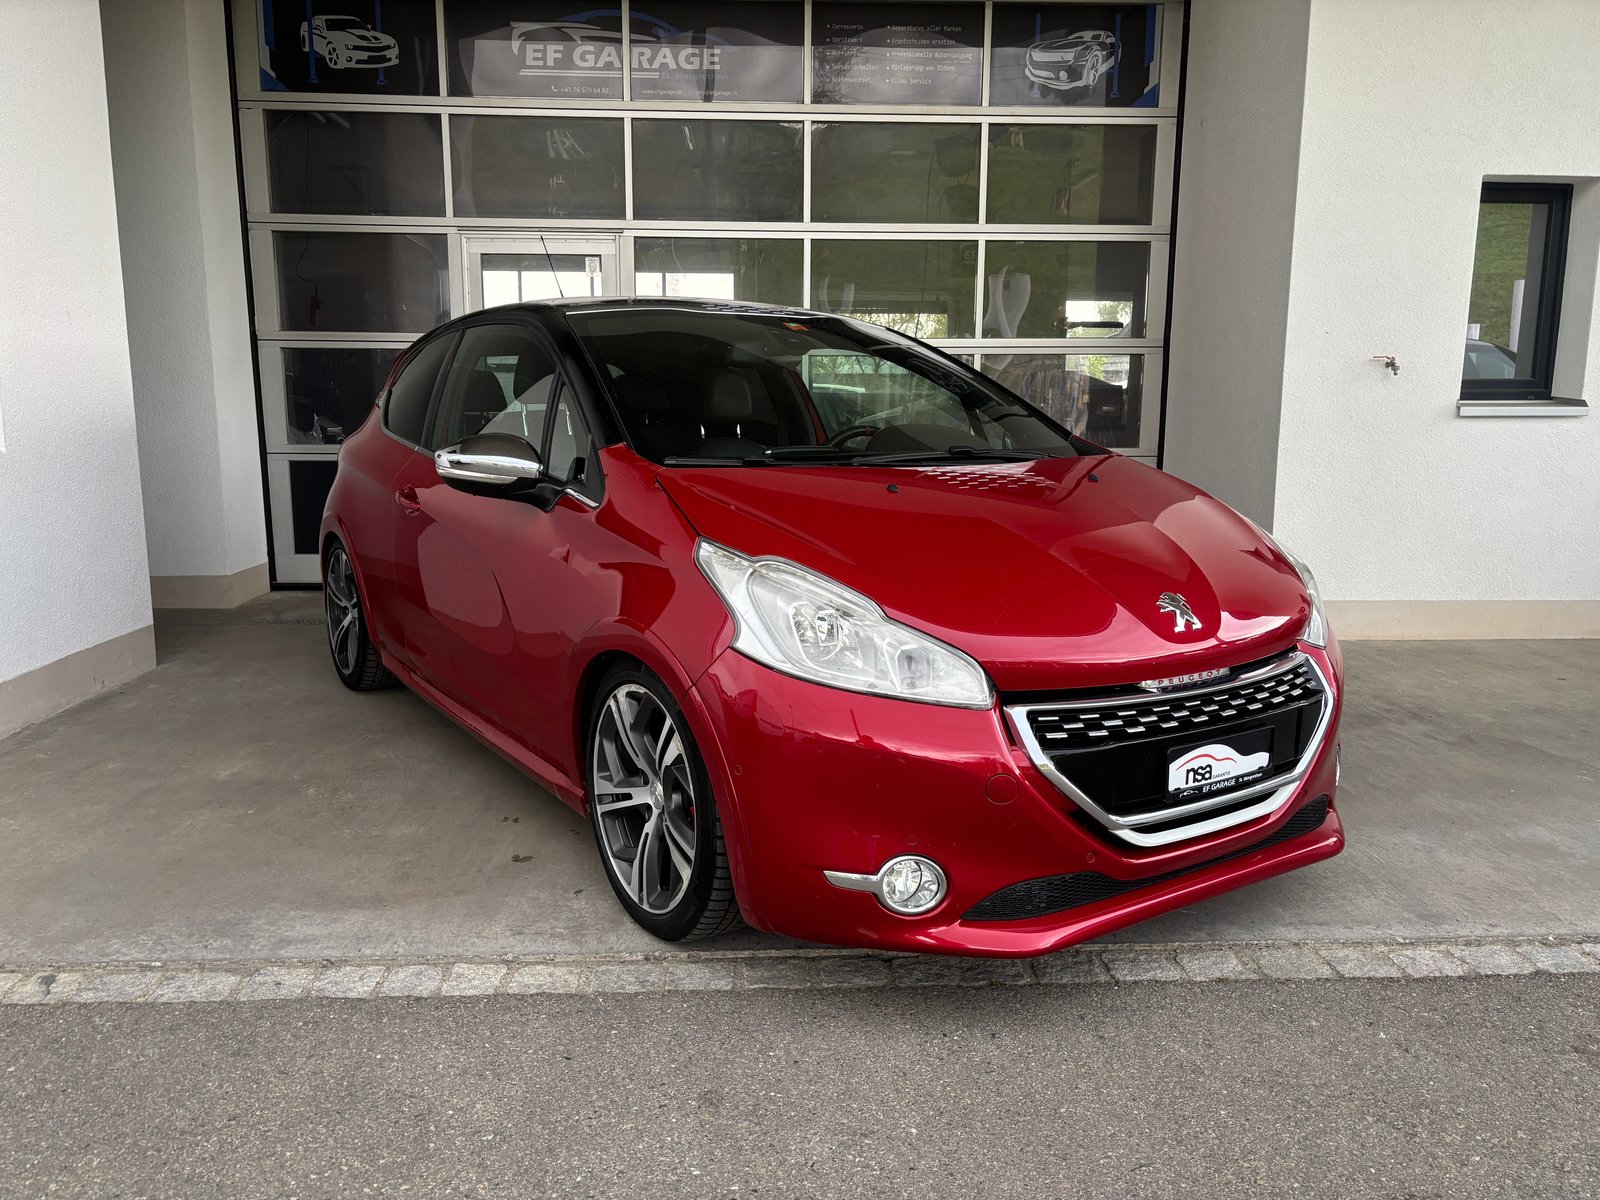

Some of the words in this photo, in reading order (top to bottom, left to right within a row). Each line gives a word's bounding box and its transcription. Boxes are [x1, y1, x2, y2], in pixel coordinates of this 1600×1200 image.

[525, 44, 563, 66] EF
[572, 45, 722, 70] GARAGE
[1157, 669, 1222, 686] PEUGEOT
[1185, 763, 1212, 785] nsa
[1202, 785, 1211, 793] EF
[1211, 779, 1236, 791] GARAGE
